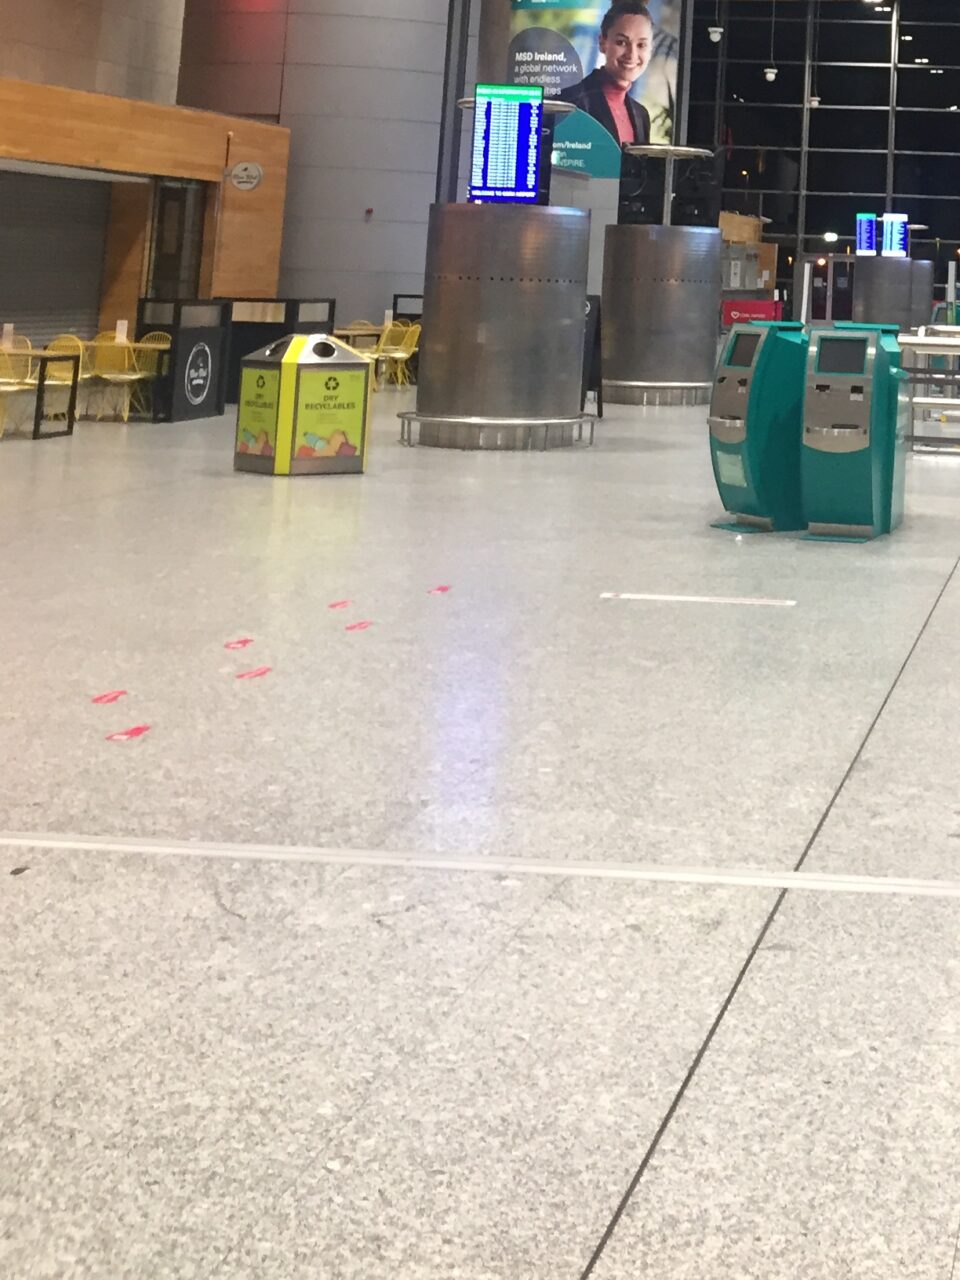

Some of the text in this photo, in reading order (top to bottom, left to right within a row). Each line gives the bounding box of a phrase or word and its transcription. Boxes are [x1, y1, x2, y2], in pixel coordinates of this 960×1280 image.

[515, 51, 567, 63] MSD Ireland,
[519, 64, 541, 74] global
[542, 64, 578, 73] network
[514, 75, 561, 84] with endless
[323, 394, 339, 402] DRY
[304, 402, 356, 410] RECYCLABLES
